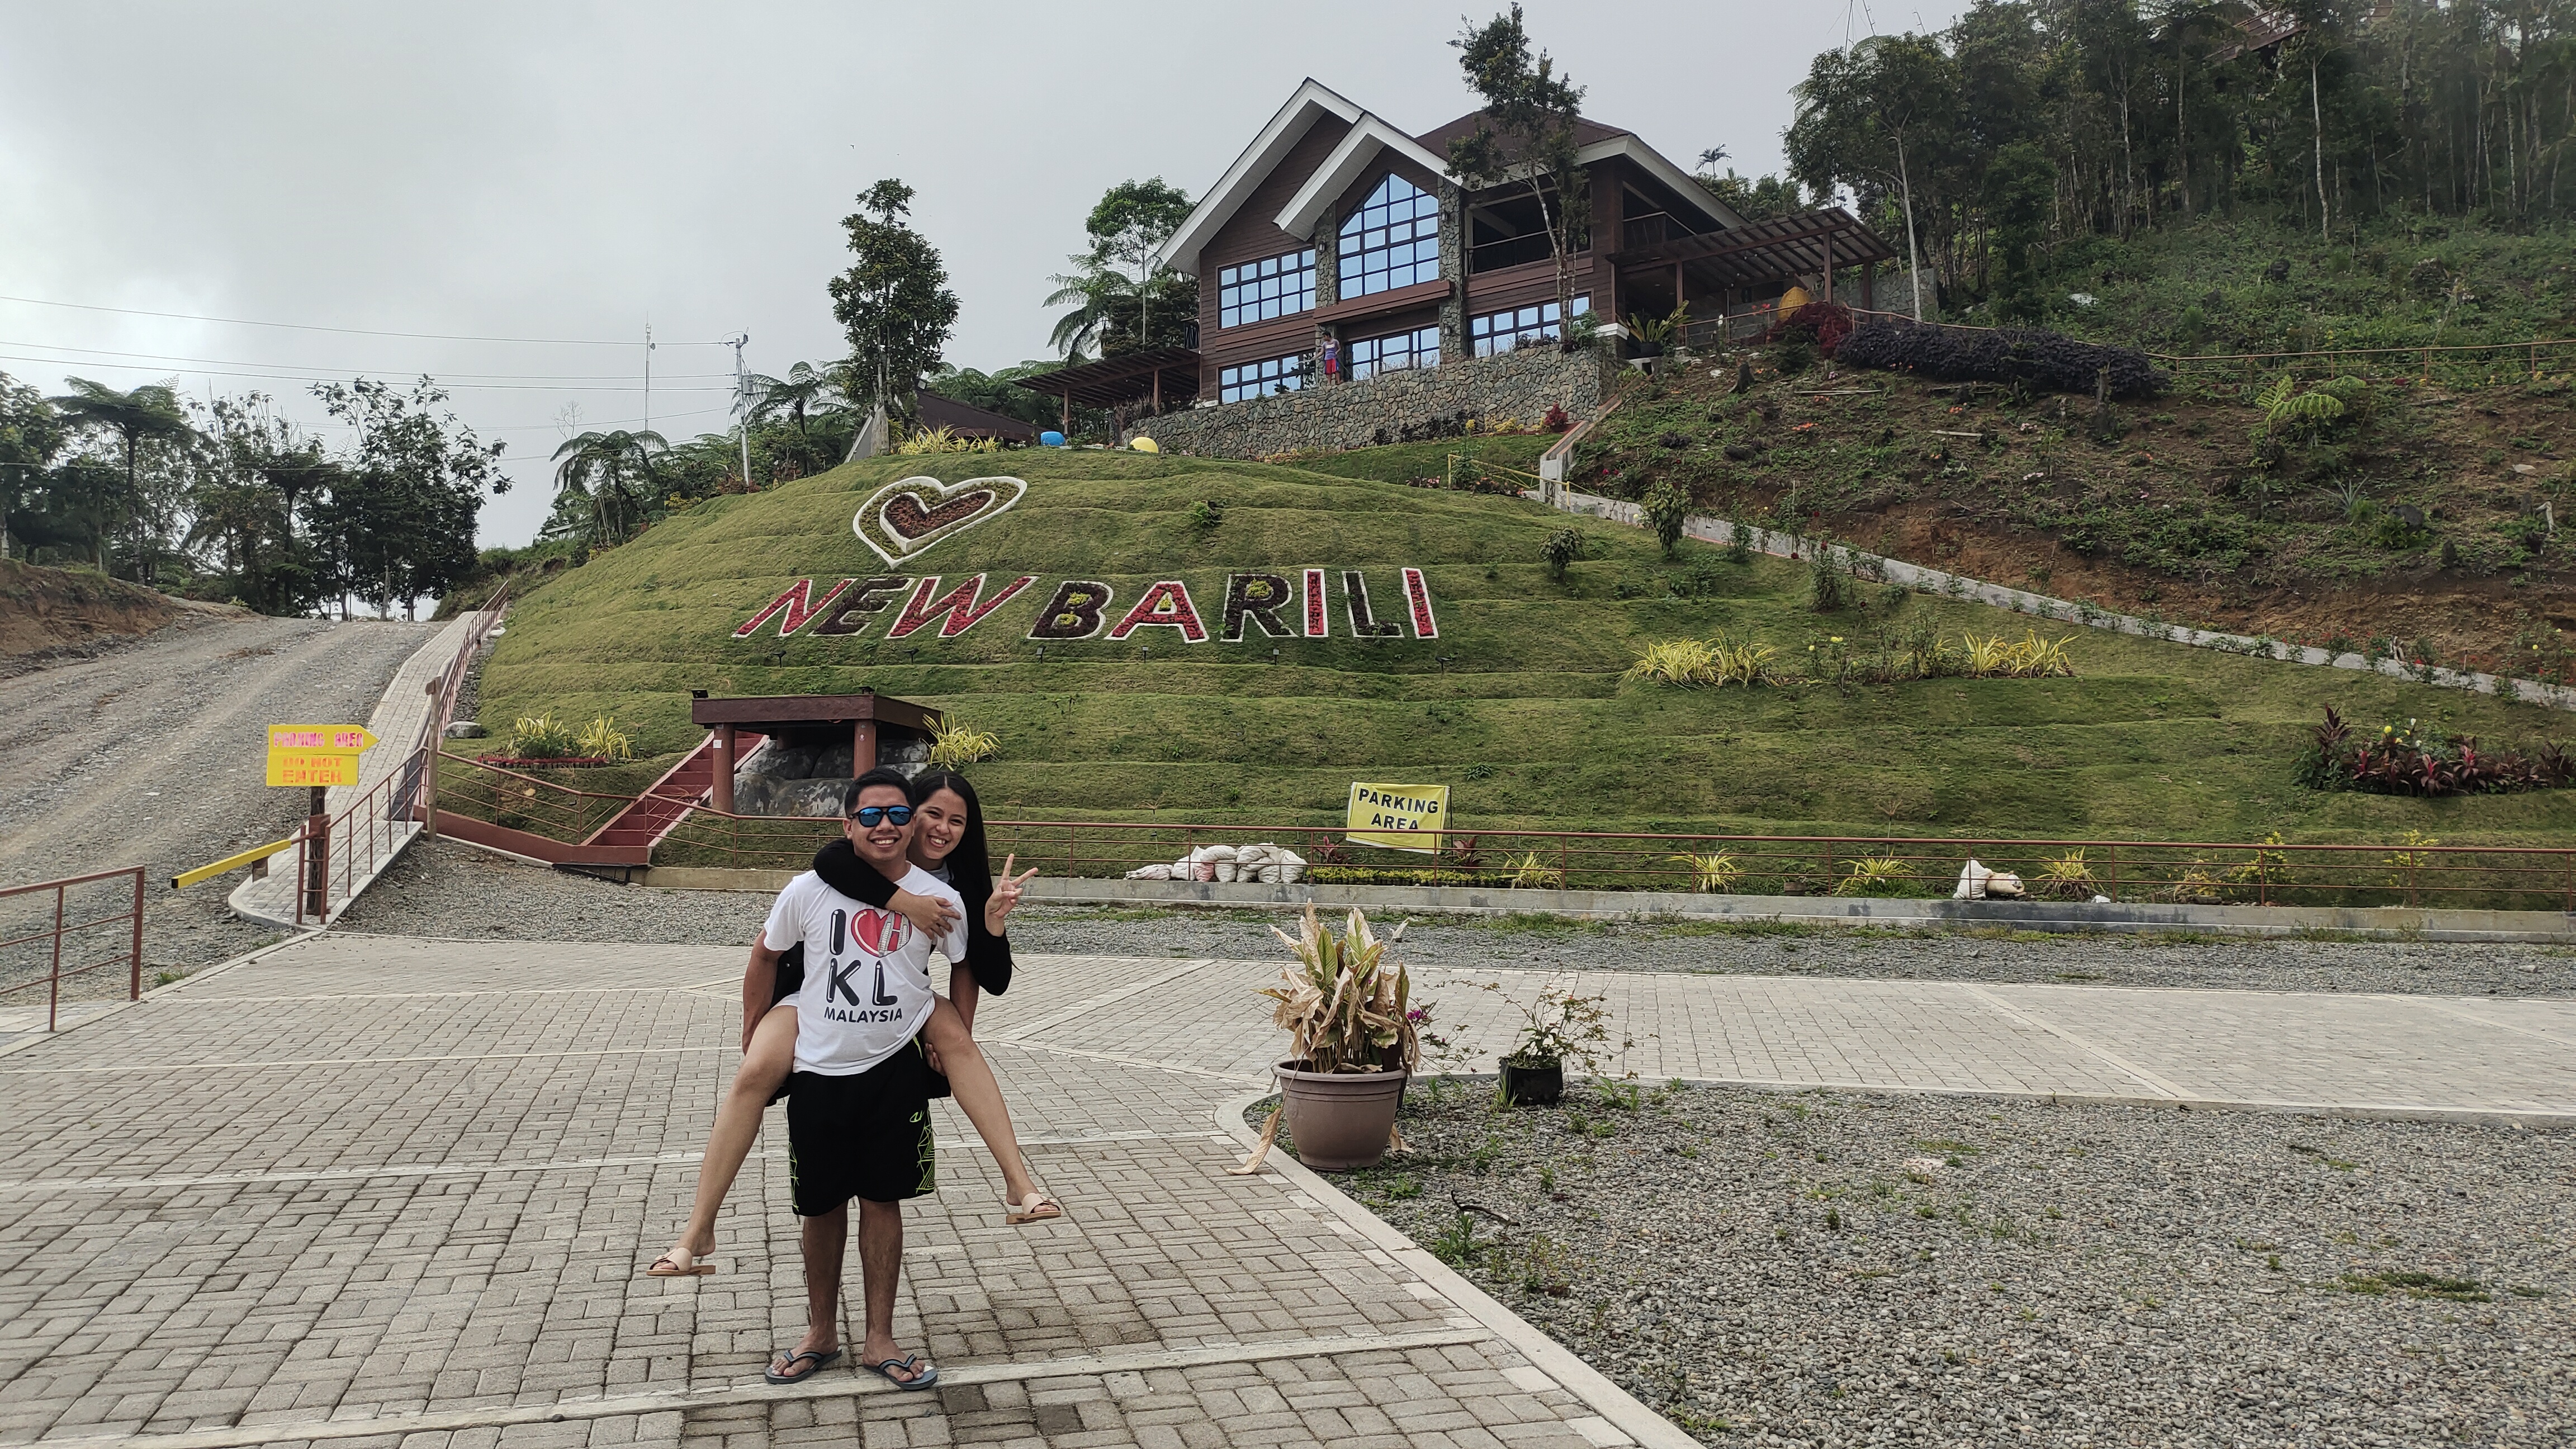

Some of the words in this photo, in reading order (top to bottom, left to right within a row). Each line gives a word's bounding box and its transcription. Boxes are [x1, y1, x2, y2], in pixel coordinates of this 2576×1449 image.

[731, 573, 1039, 639] NEW
[1026, 567, 1439, 643] BARILI
[274, 732, 325, 747] PARKING
[334, 732, 363, 747] AREA
[283, 757, 305, 768] DO
[310, 757, 343, 768] NOT
[282, 770, 342, 783] ENTER
[1358, 788, 1439, 814] PARKING
[1371, 812, 1419, 830] AREA
[830, 908, 846, 955] I
[824, 1006, 903, 1023] MALAYSIA
